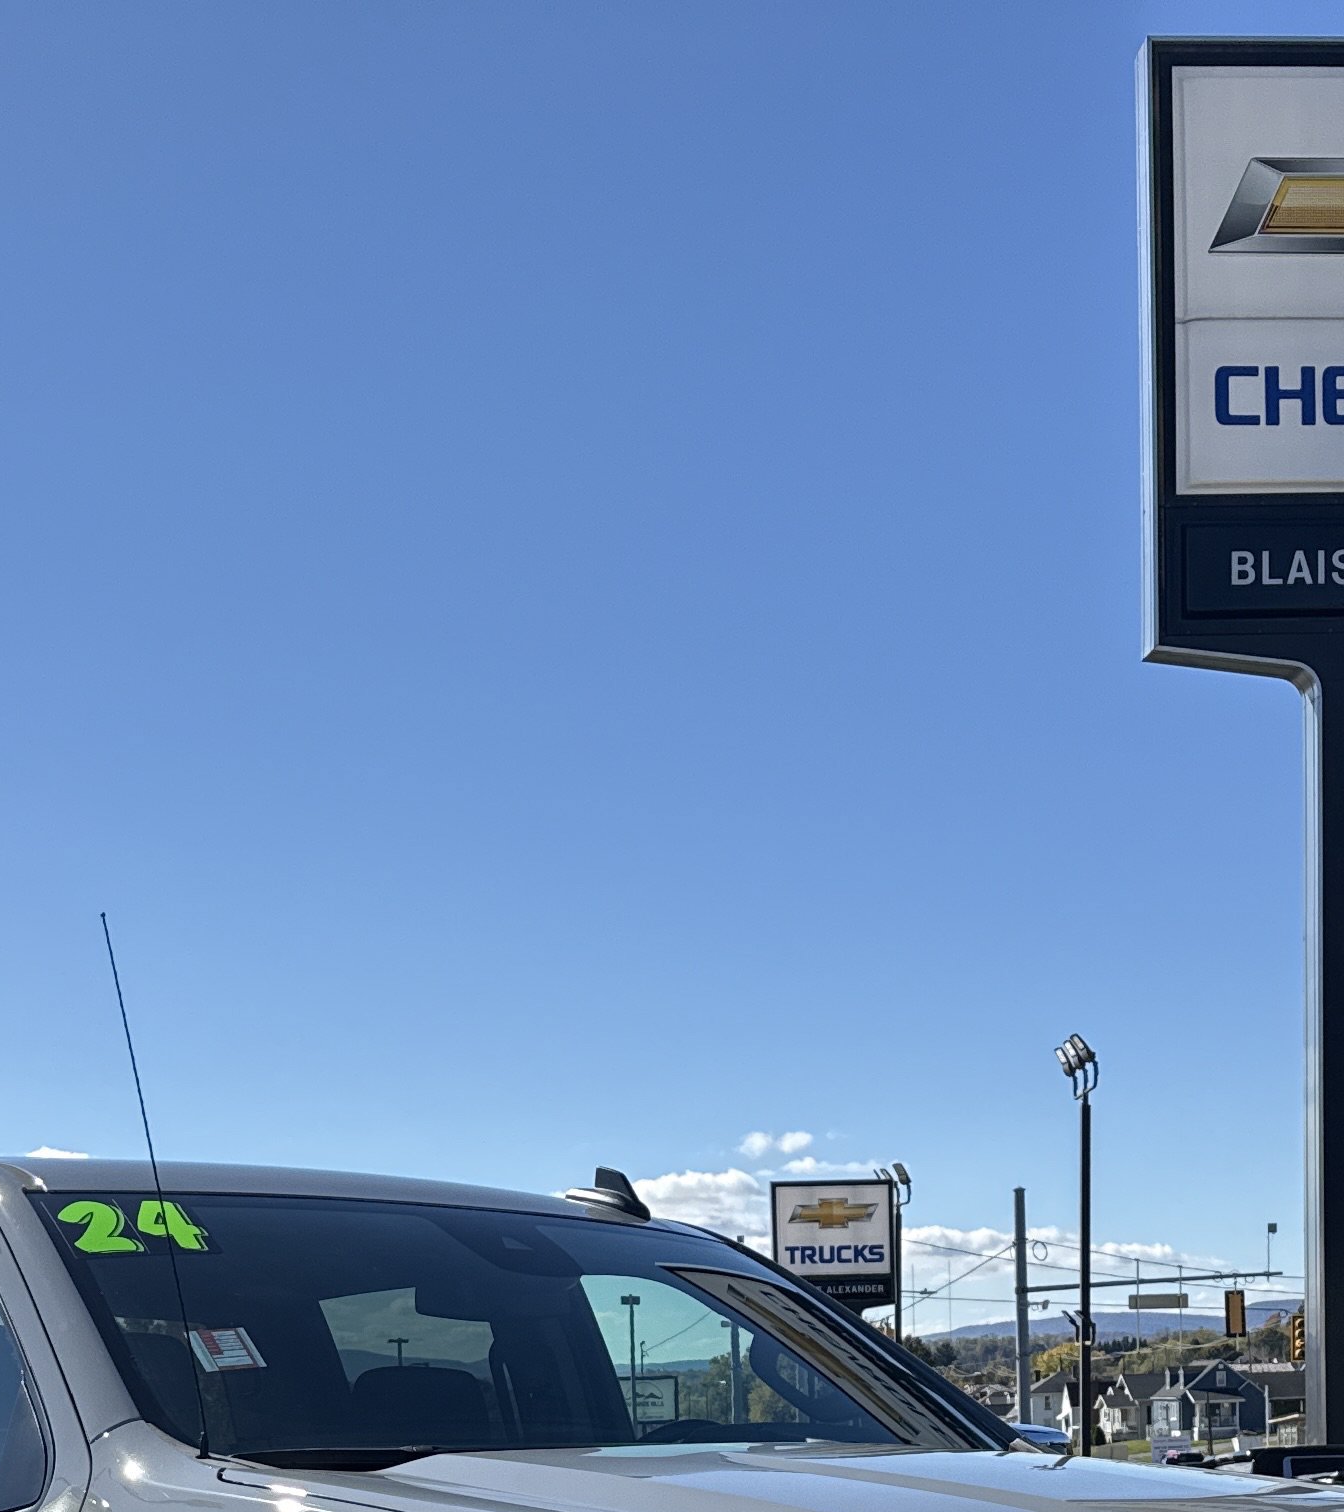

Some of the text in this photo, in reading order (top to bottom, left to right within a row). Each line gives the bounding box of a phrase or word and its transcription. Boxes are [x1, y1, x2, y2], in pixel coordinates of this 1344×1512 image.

[58, 1199, 209, 1253] 24
[784, 1244, 885, 1265] TRUCKS
[826, 1284, 884, 1294] ALEXANDER
